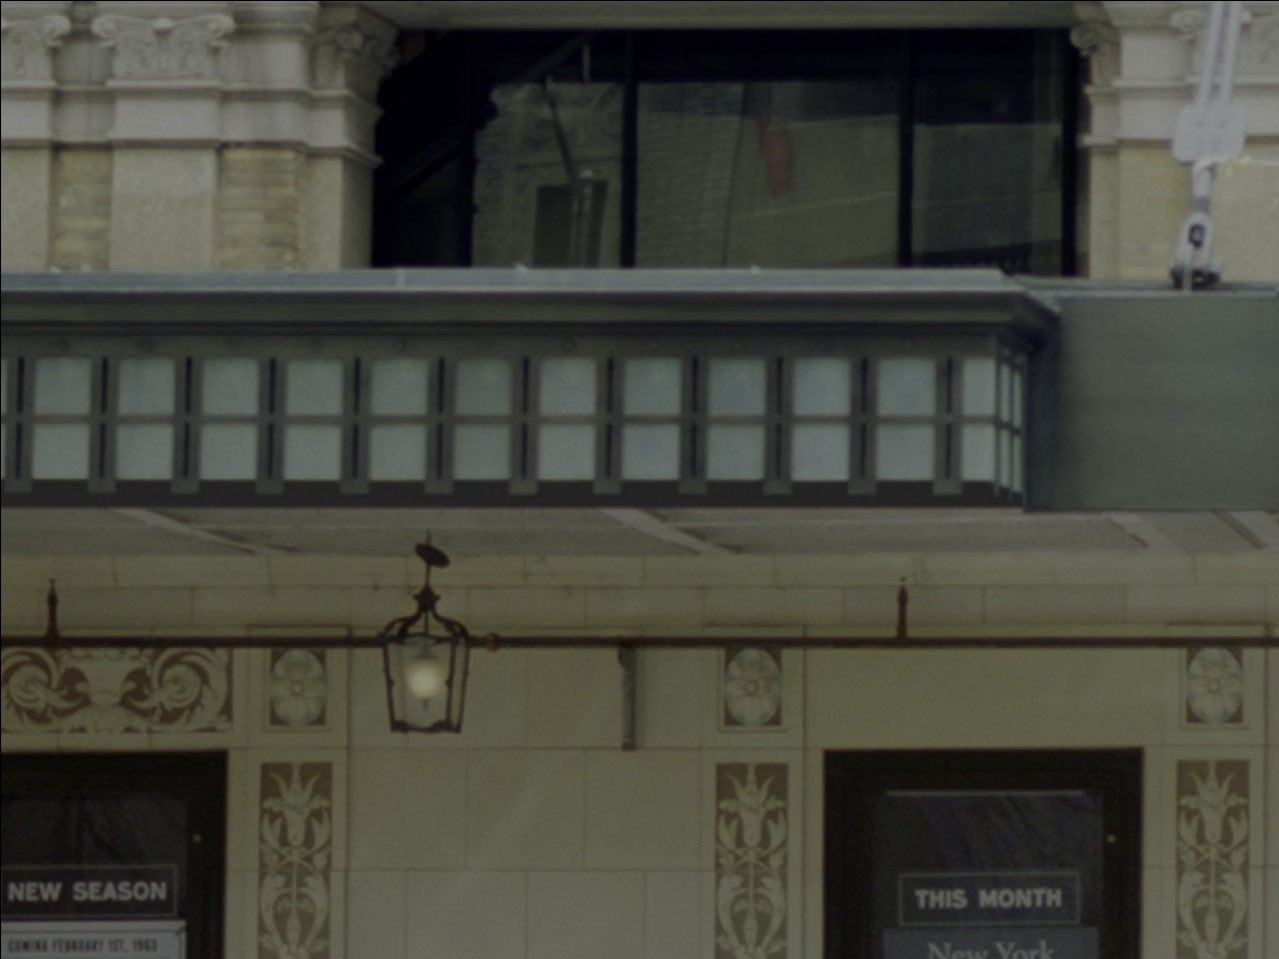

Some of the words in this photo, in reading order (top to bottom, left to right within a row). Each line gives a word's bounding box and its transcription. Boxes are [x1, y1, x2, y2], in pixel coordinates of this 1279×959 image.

[8, 882, 61, 901] NEW
[73, 881, 167, 900] SEASON
[915, 889, 967, 909] THIS
[978, 888, 1062, 908] MONTH
[8, 939, 47, 953] COMING
[53, 939, 103, 952] FEBRUARY
